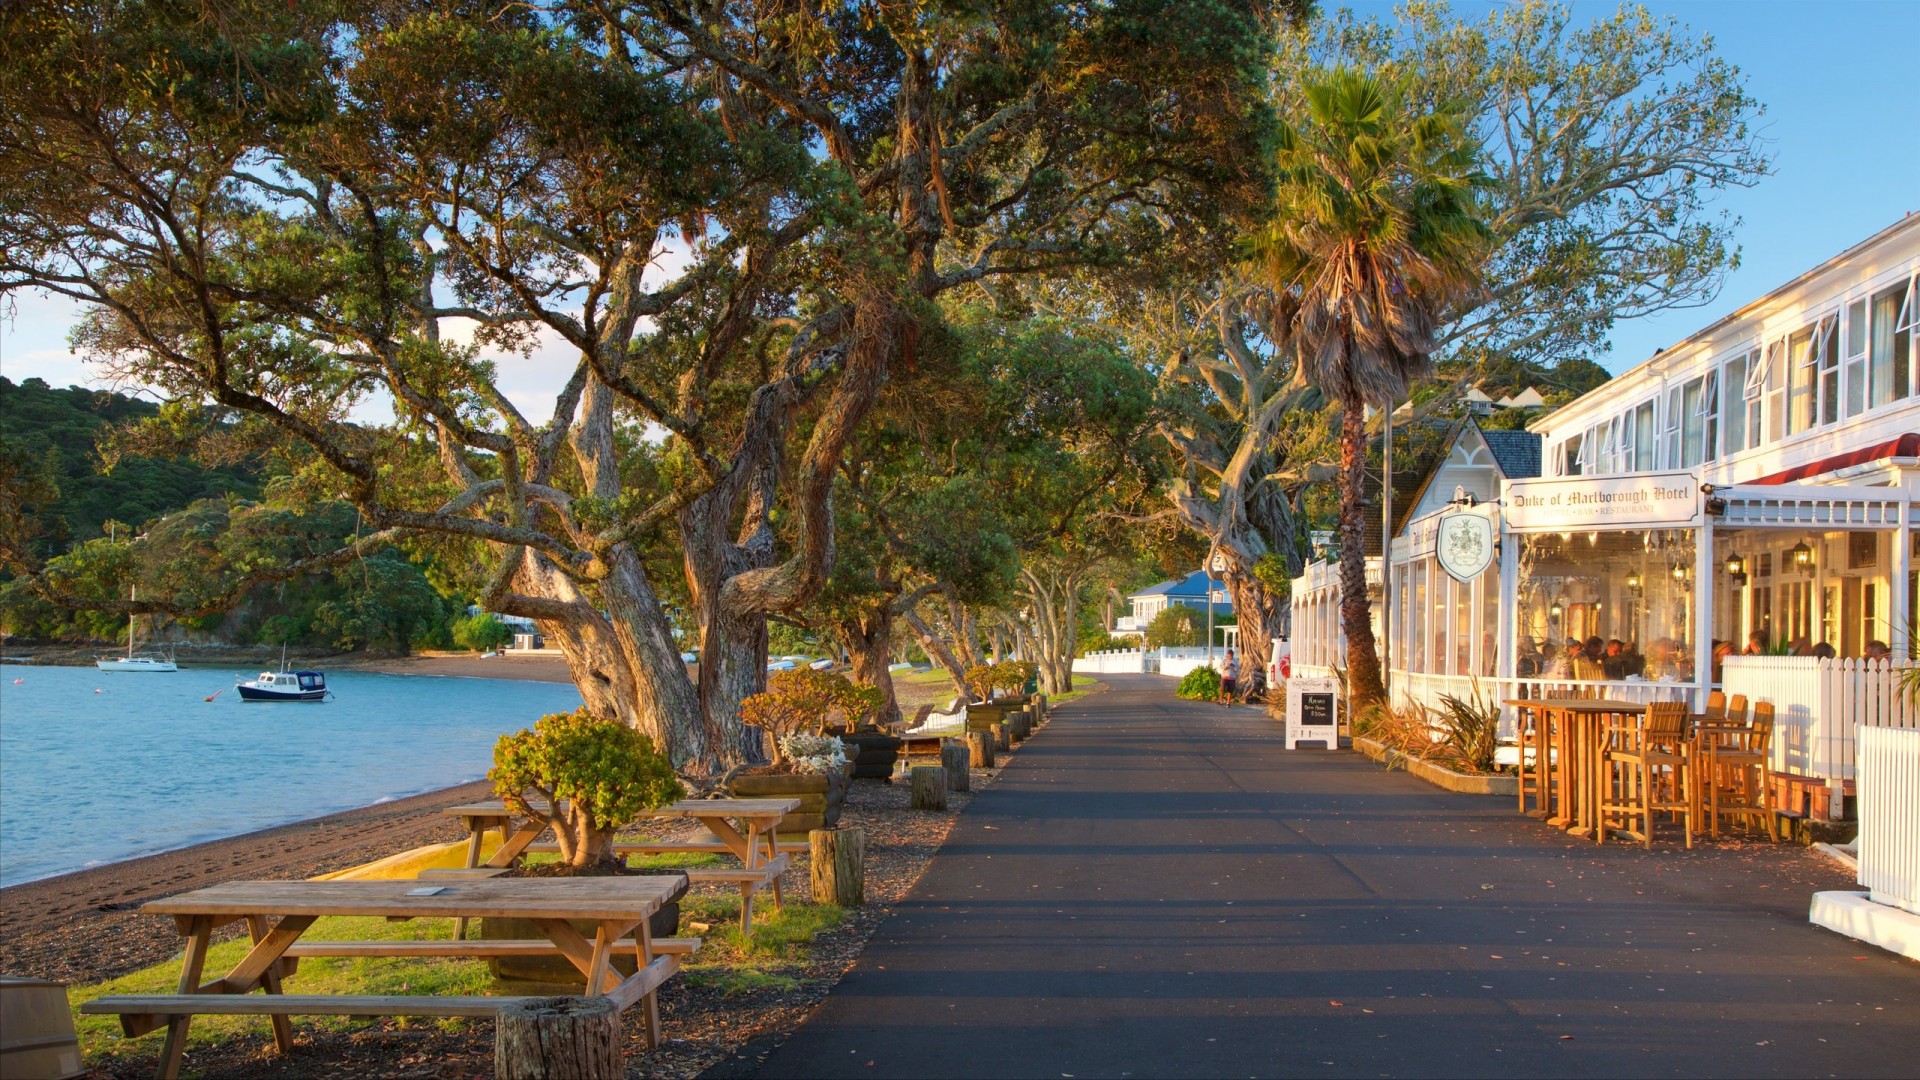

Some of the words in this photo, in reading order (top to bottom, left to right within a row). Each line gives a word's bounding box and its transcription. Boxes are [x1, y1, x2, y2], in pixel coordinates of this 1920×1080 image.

[1514, 494, 1545, 507] Duke
[1550, 492, 1562, 505] of
[1567, 488, 1648, 505] Marlborough
[1654, 486, 1689, 499] Hotel
[1577, 507, 1594, 516] BAR
[1600, 505, 1654, 515] RESTAURANT
